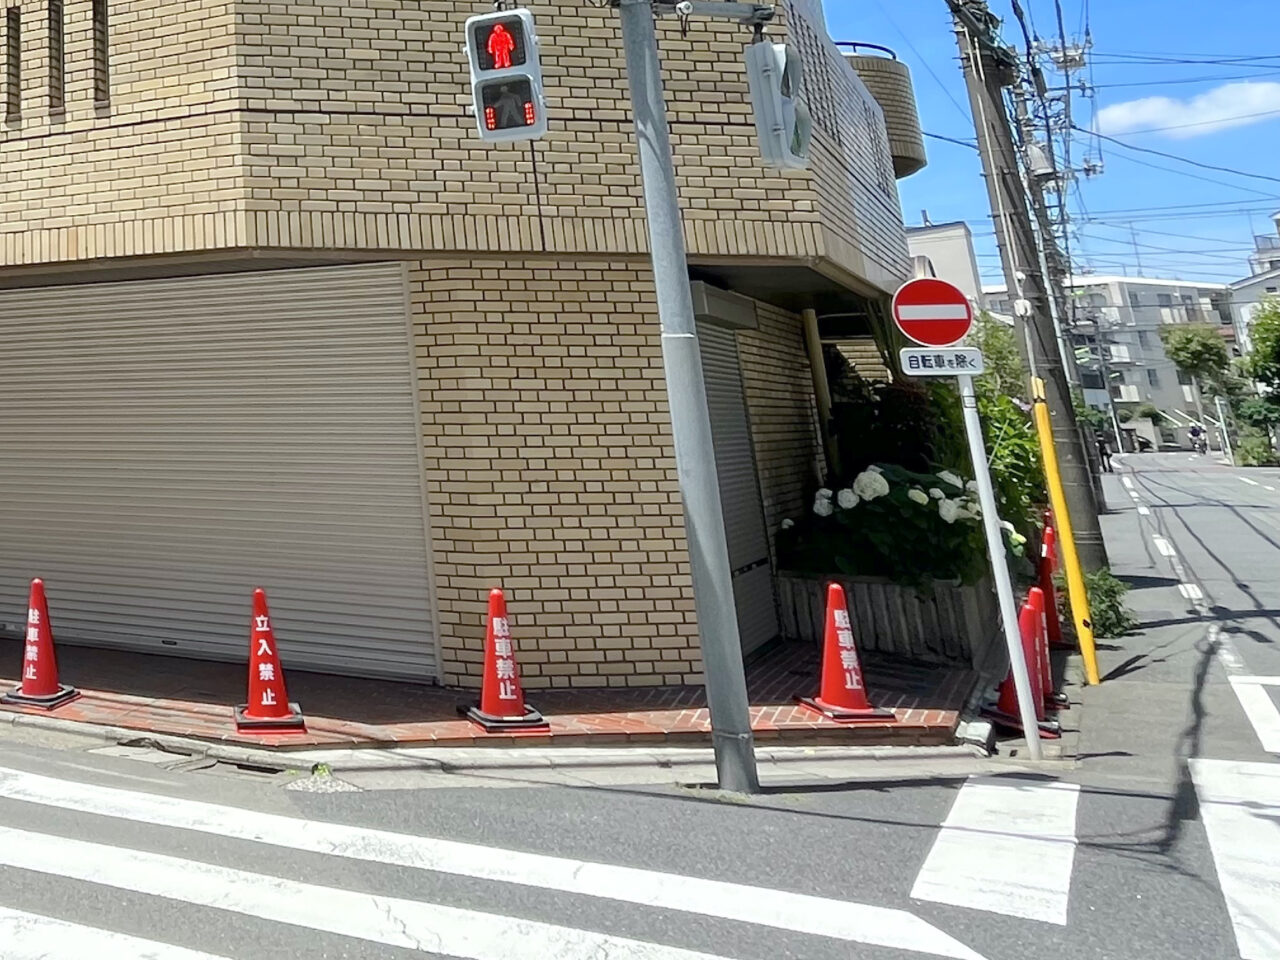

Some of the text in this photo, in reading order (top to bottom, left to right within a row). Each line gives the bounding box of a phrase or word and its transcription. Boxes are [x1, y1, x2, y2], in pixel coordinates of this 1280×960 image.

[908, 353, 977, 369] 自転車を除く
[25, 608, 40, 680] 駐車禁止
[255, 614, 277, 706] 立入禁止
[492, 617, 517, 700] 駐車禁止
[833, 609, 862, 690] 駐車禁止
